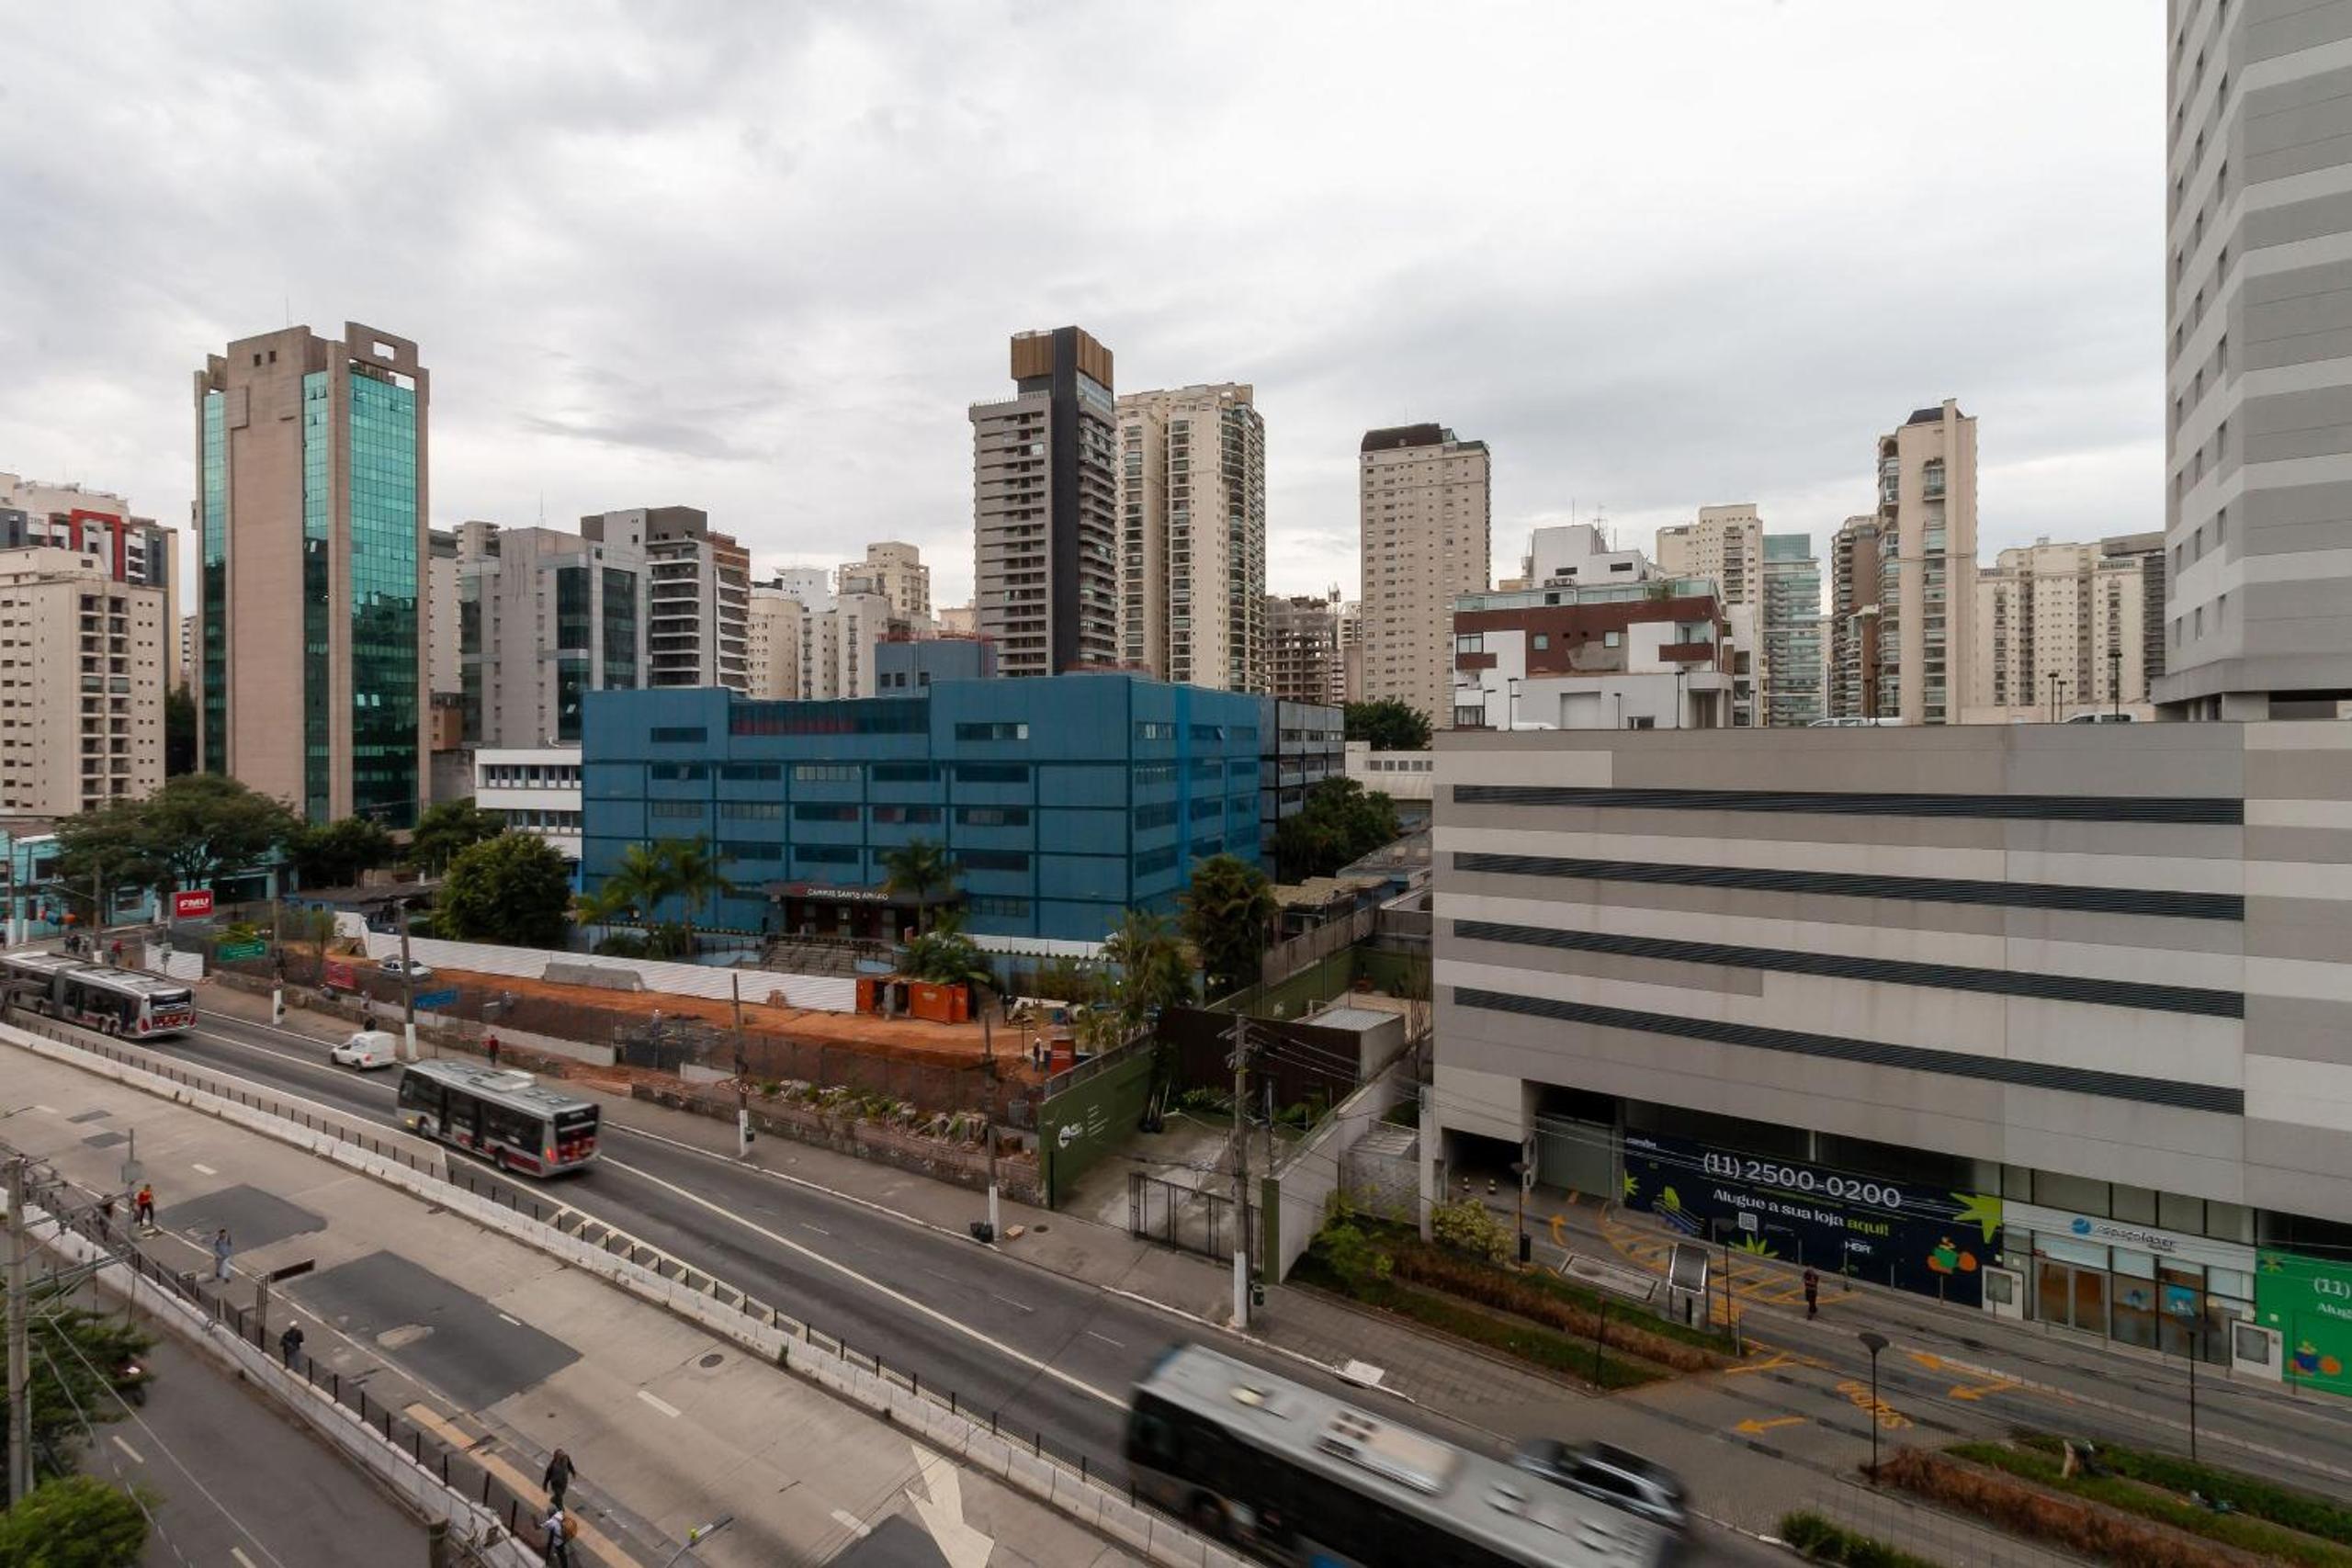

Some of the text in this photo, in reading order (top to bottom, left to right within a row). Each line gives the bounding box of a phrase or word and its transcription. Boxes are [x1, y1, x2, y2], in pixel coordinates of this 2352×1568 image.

[1704, 1152, 1901, 1208] (11) 2500-0200
[1713, 1189, 1889, 1236] Alugue a sua loja aqui!
[2314, 1277, 2350, 1300] (11)
